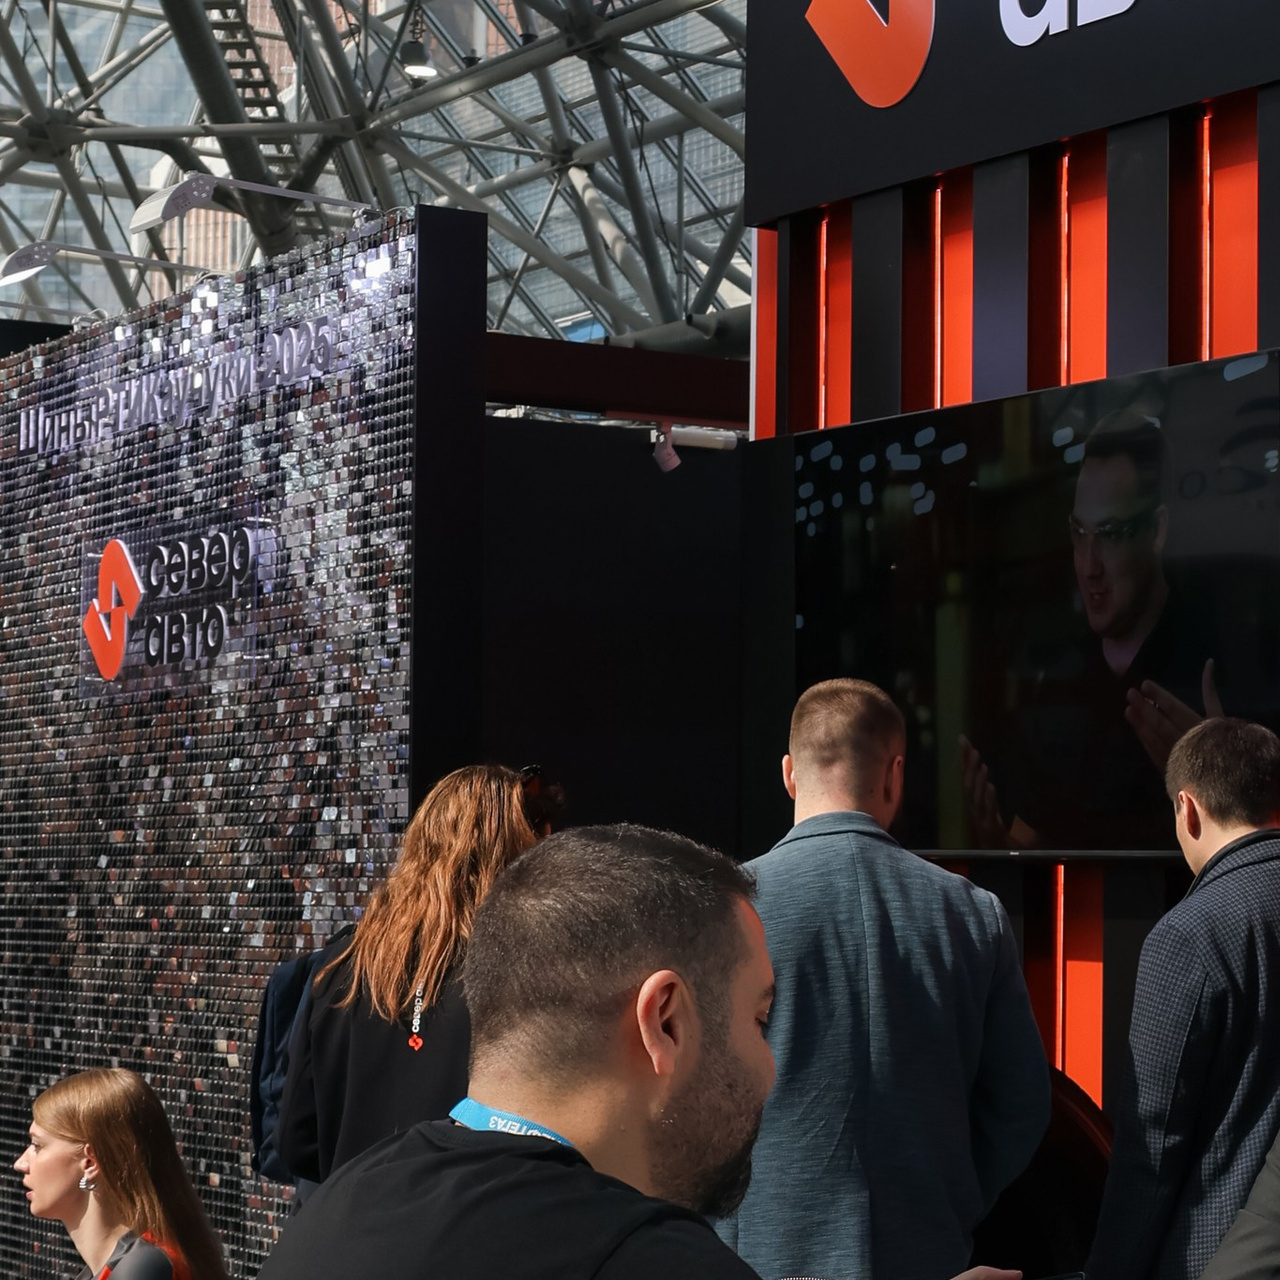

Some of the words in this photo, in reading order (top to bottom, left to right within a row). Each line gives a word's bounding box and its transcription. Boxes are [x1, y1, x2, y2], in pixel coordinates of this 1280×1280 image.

[258, 320, 331, 389] 2025
[146, 527, 250, 599] север
[144, 605, 224, 668] авто
